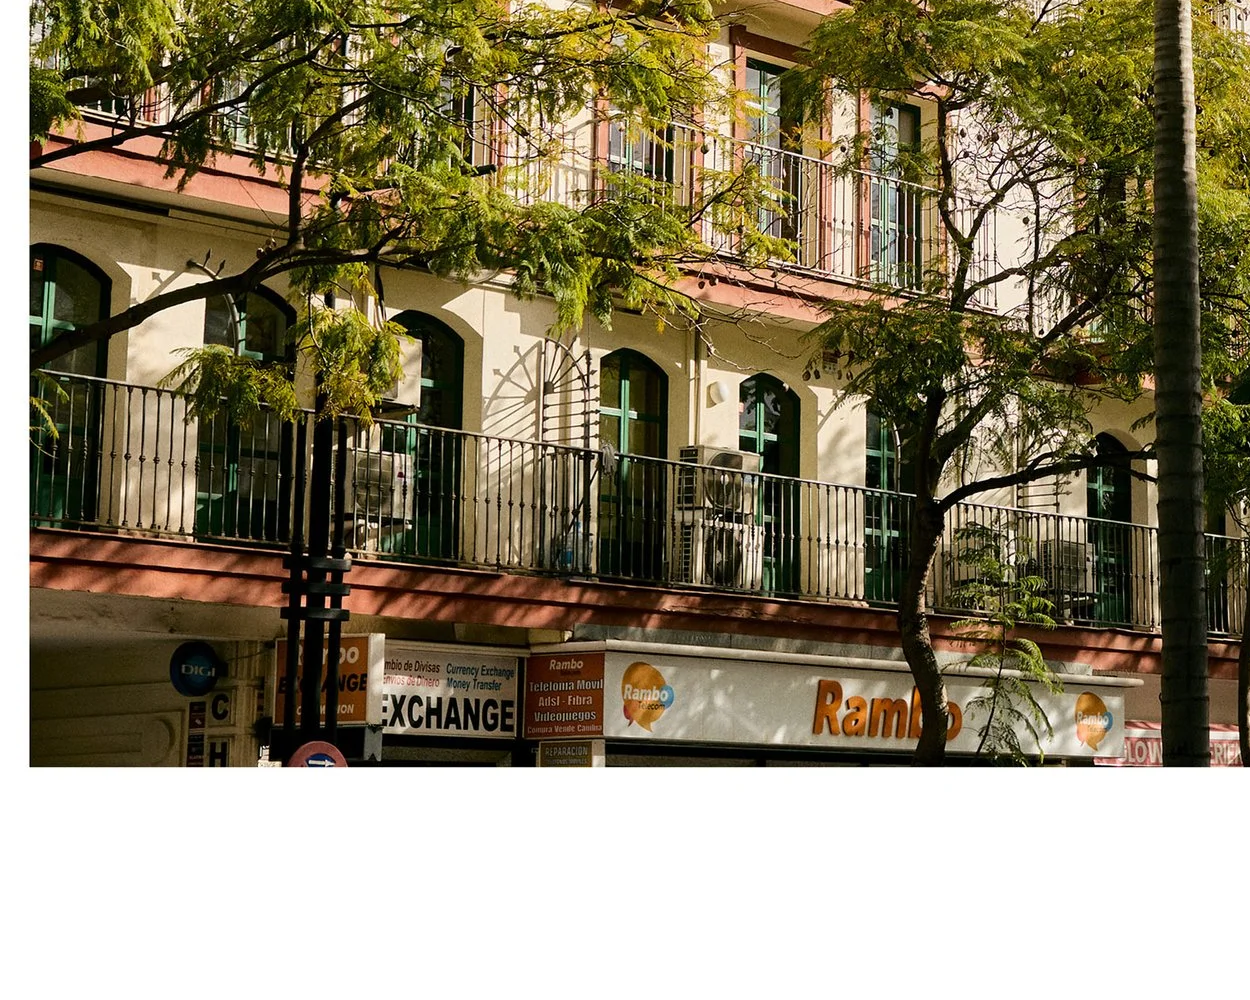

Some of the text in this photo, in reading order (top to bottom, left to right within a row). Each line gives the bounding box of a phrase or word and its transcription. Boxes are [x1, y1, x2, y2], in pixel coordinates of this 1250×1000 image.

[181, 663, 216, 678] DIGI
[383, 658, 441, 674] mbio de Divisas
[446, 663, 515, 680] Currency Exchange
[549, 658, 584, 671] Rambo
[406, 674, 416, 687] de
[416, 675, 440, 688] Dinero
[446, 677, 503, 692] Money Transfer
[623, 683, 669, 702] Rambo
[534, 710, 597, 723] Videojuegos
[1077, 711, 1110, 726] Rambo
